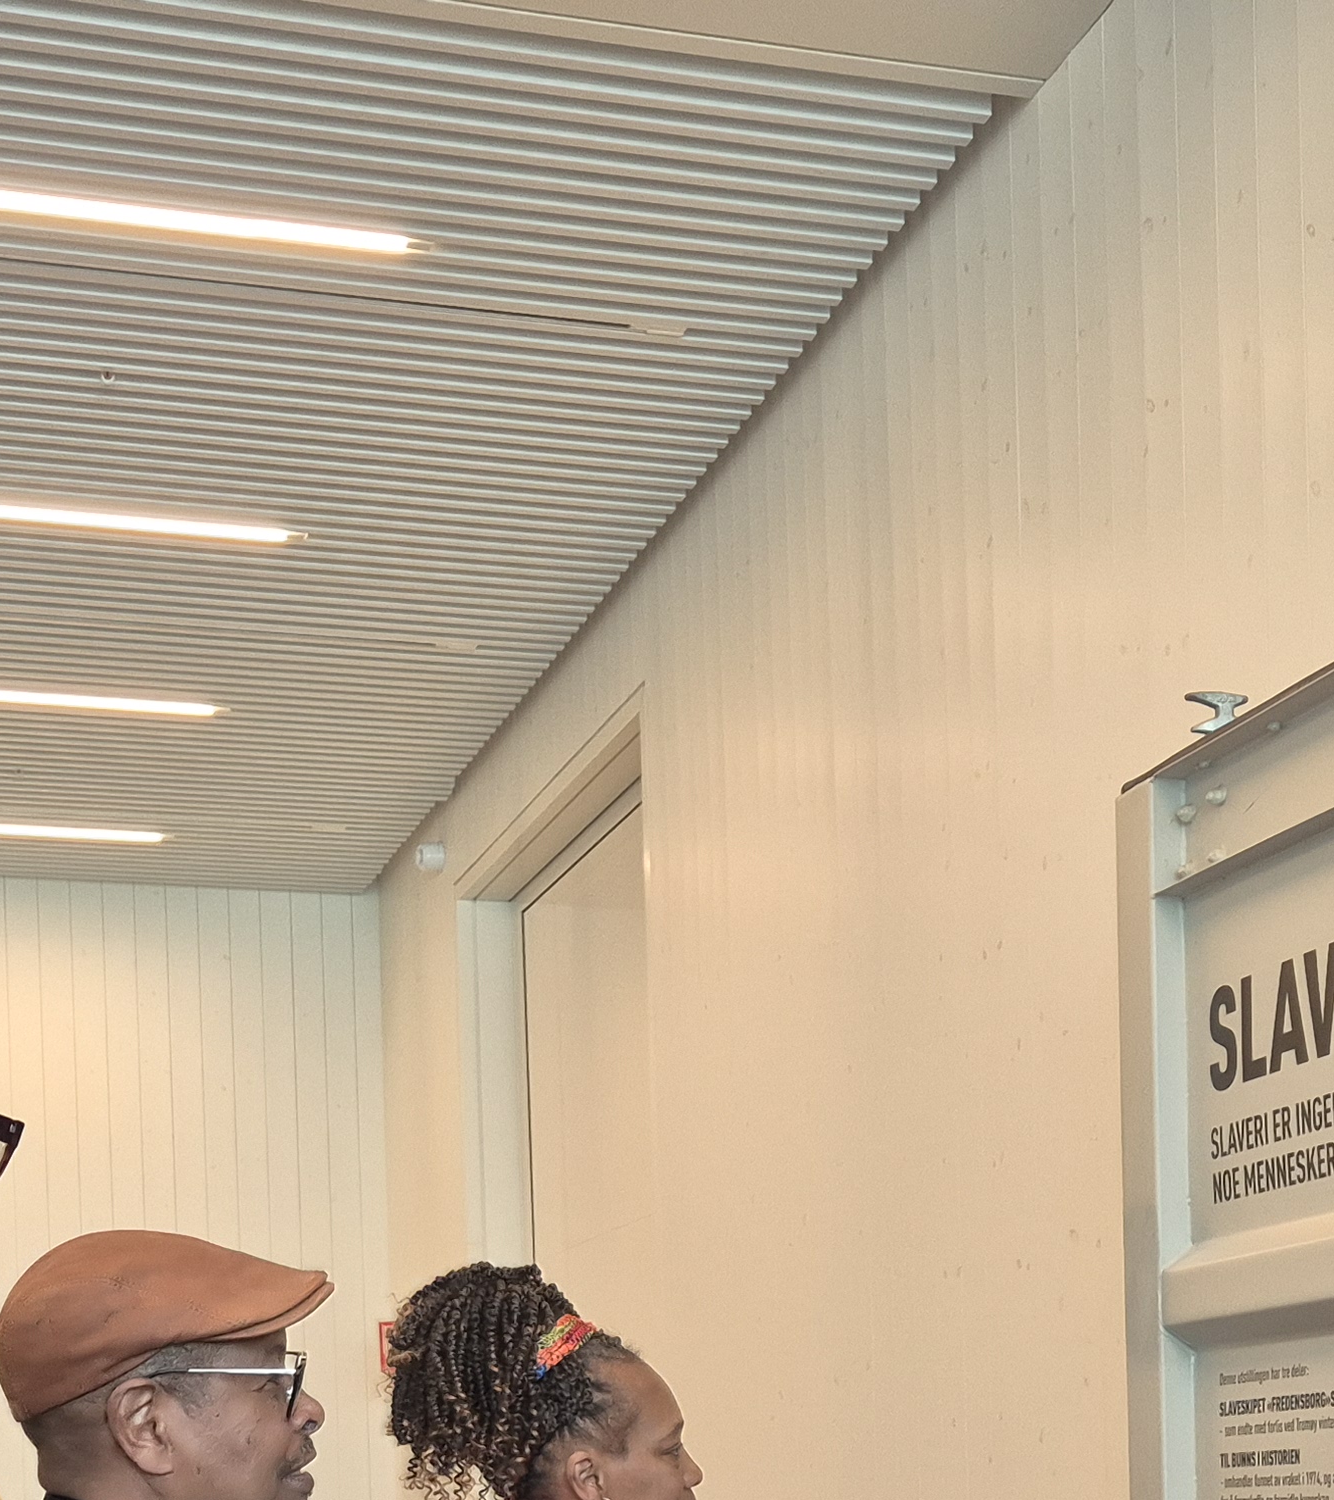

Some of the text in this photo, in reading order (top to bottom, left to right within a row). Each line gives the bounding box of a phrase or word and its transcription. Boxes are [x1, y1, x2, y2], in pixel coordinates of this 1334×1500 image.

[1211, 1117, 1270, 1160] SLAVERI
[1273, 1108, 1292, 1145] ER
[1212, 1167, 1241, 1205] NOE
[1219, 1397, 1266, 1417] SLAVESKIPET
[1219, 1452, 1231, 1468] TIL
[1231, 1451, 1256, 1467] BUNNS
[1261, 1448, 1301, 1466] HISTORIEN
